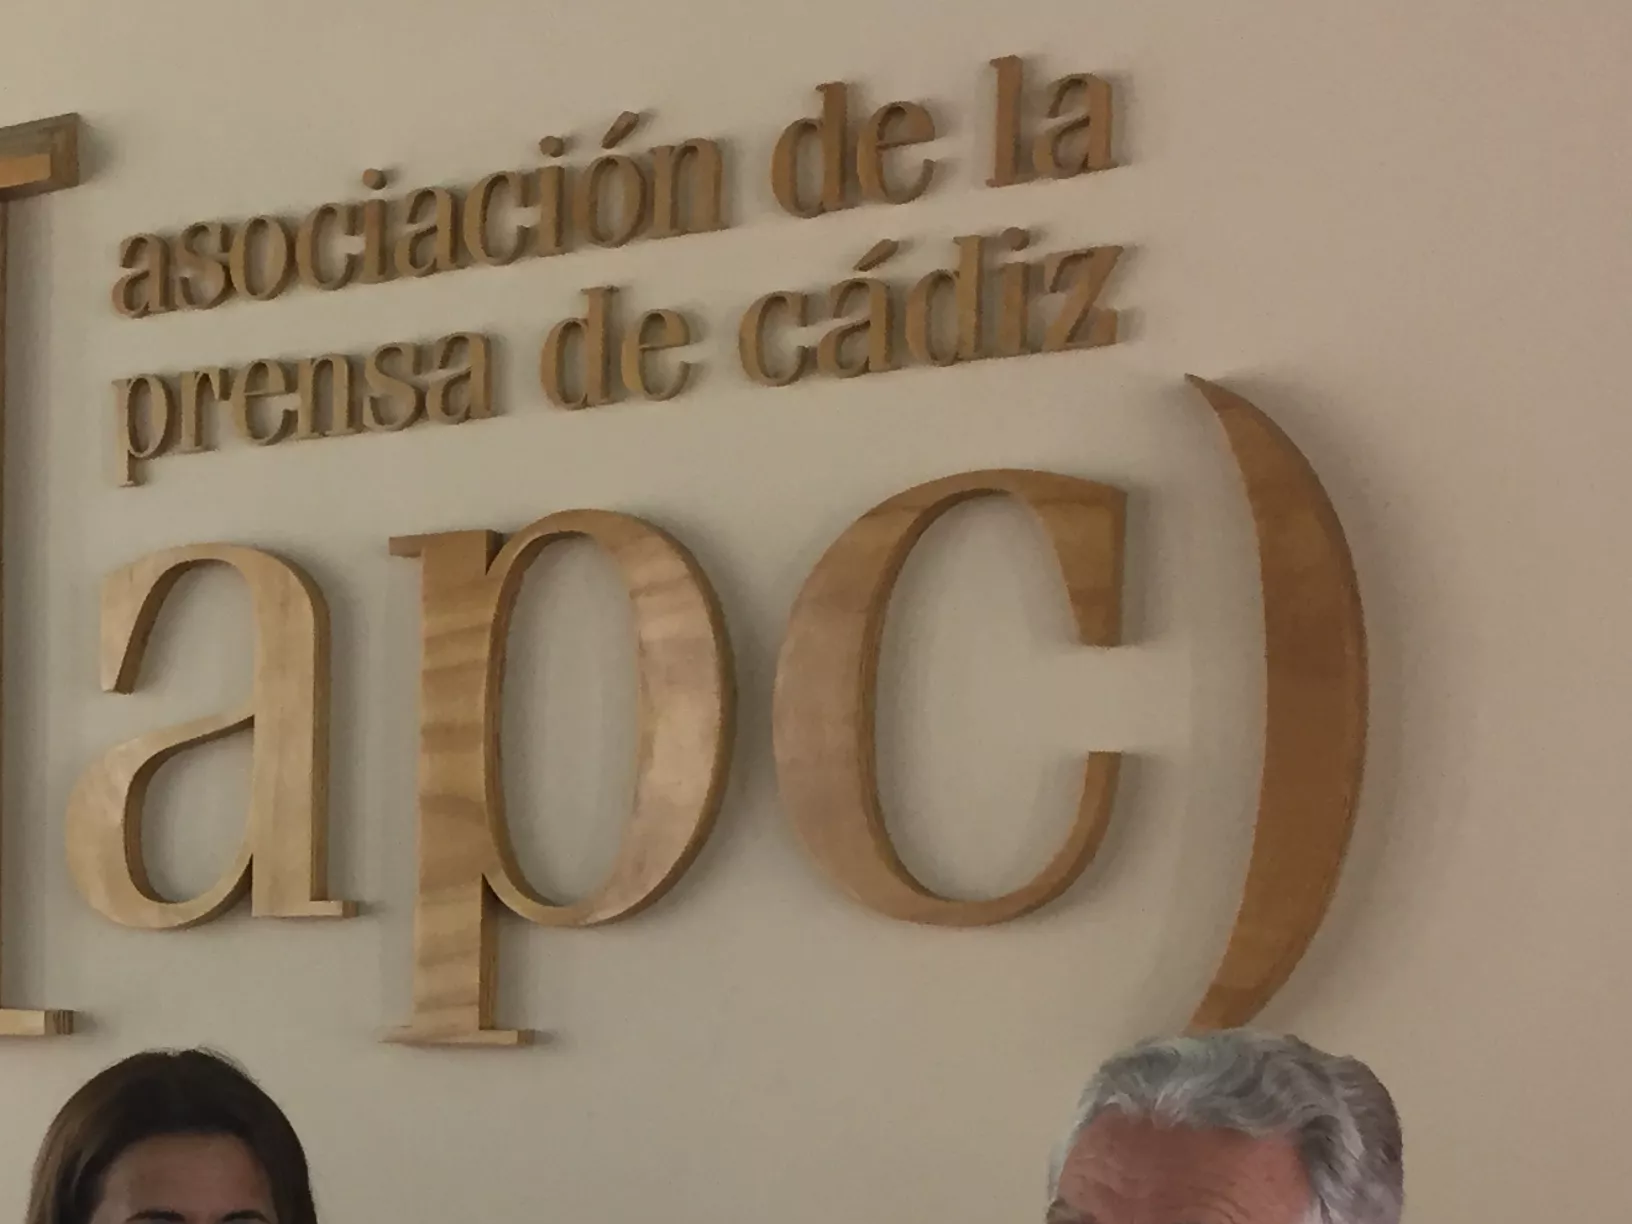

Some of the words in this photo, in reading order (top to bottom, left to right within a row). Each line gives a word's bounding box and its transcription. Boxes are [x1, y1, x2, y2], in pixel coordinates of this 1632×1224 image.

[110, 110, 729, 320] asociación
[772, 80, 943, 220] de
[985, 54, 1118, 191] la
[110, 320, 500, 489] prensa
[539, 284, 695, 411] de
[738, 226, 1135, 389] cádiz
